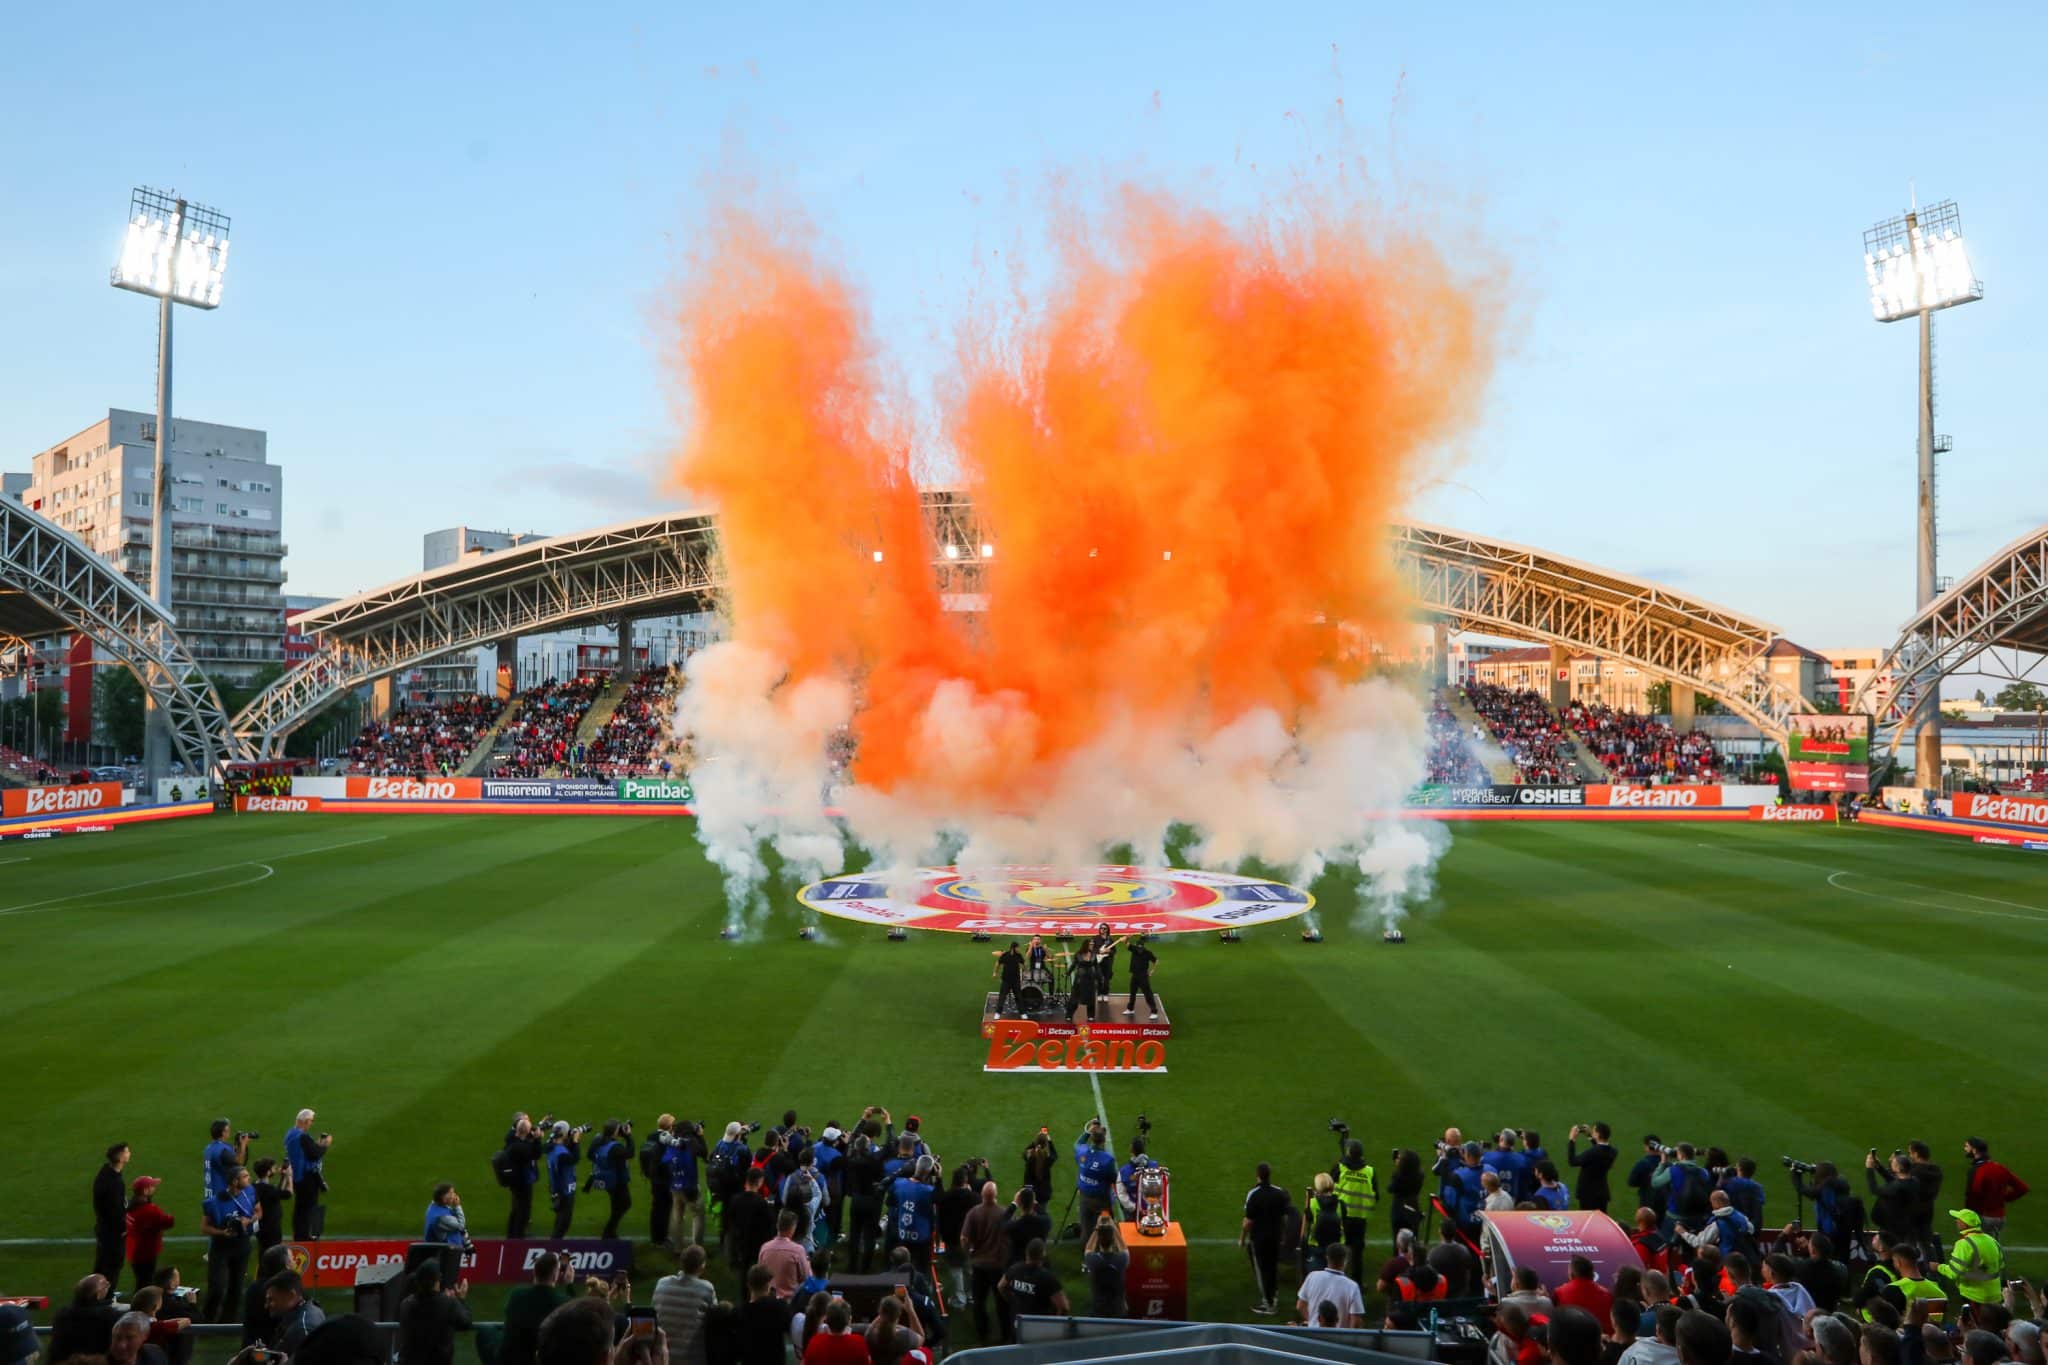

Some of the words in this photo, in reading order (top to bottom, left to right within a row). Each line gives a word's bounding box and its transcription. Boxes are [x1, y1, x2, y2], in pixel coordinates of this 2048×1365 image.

[368, 777, 455, 799] Betano
[625, 781, 690, 799] Pambac
[1520, 788, 1582, 804] OSHEE
[1609, 785, 1697, 807] Betano
[26, 788, 103, 813] Betano
[246, 796, 308, 812] Betano
[1483, 795, 1512, 804] GREAT
[1762, 804, 1824, 821] Betano
[1970, 794, 2048, 824] Betano
[956, 919, 1167, 930] Betano
[986, 1020, 1166, 1070] Betano
[903, 1200, 915, 1212] 42
[316, 1254, 368, 1269] CUPA
[522, 1248, 613, 1270] Bano
